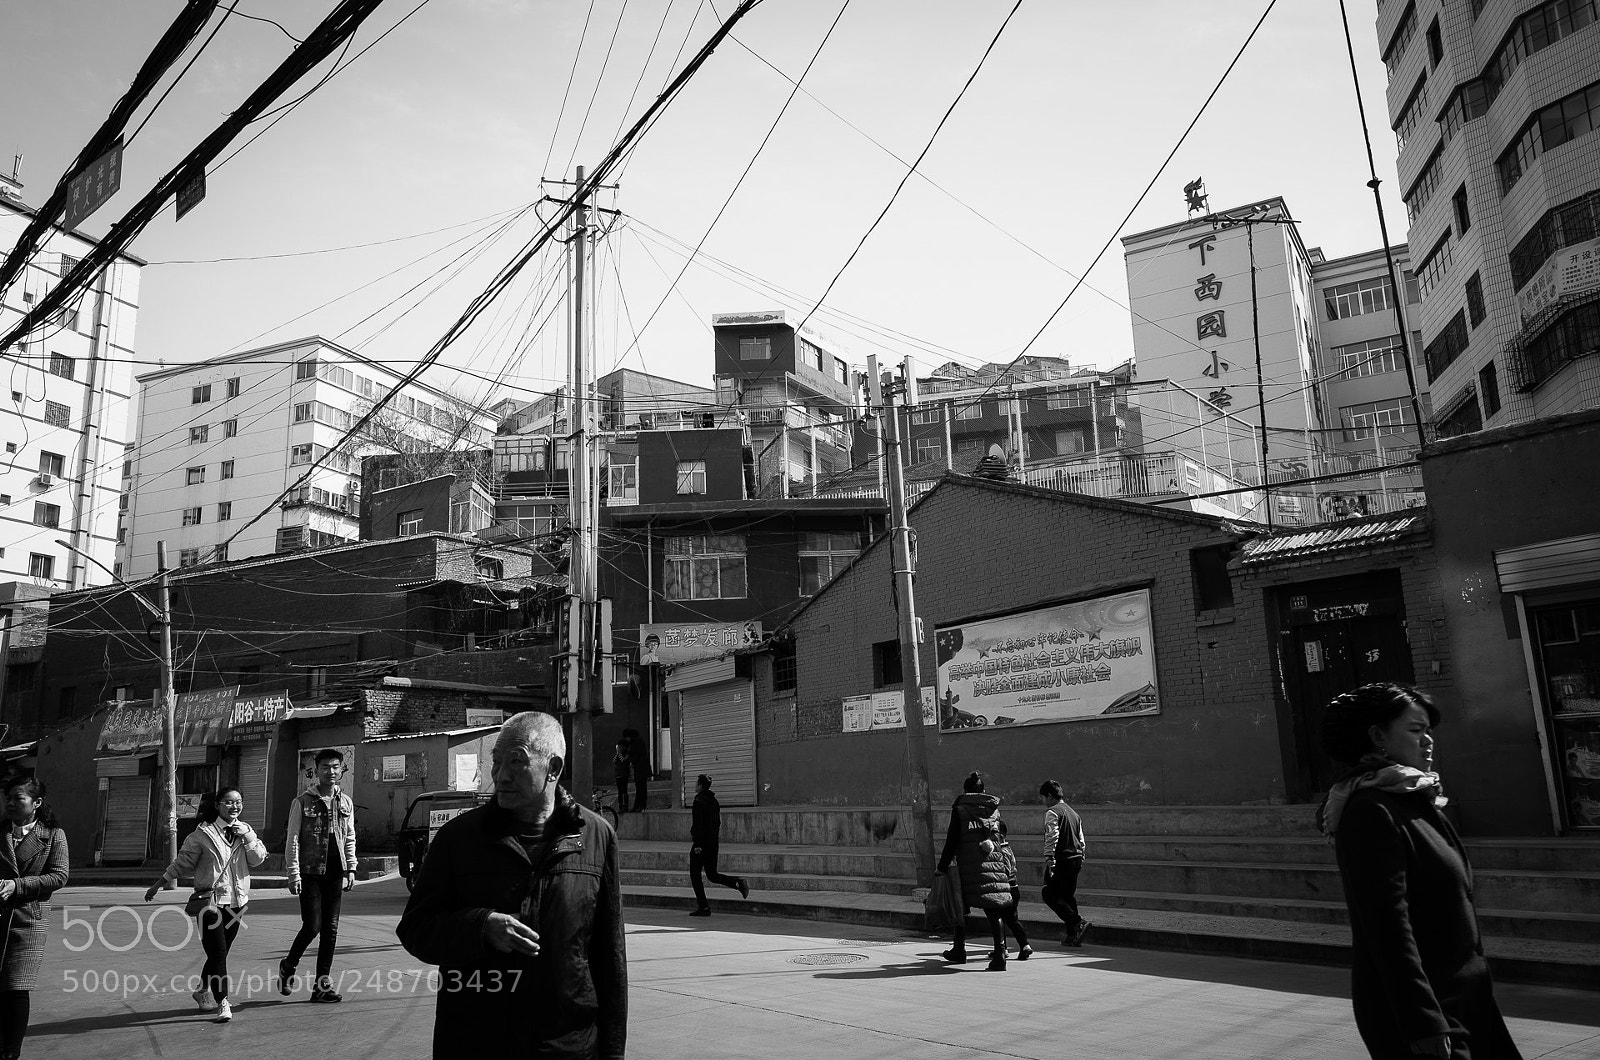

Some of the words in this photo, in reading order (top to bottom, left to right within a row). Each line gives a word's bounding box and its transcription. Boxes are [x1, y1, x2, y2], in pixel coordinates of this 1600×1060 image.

[1188, 235, 1233, 417] 下西园小学
[948, 636, 1143, 682] 高举中国特色社会主义伟大旗帜
[973, 662, 1111, 697] 决胜全面建成小康社会
